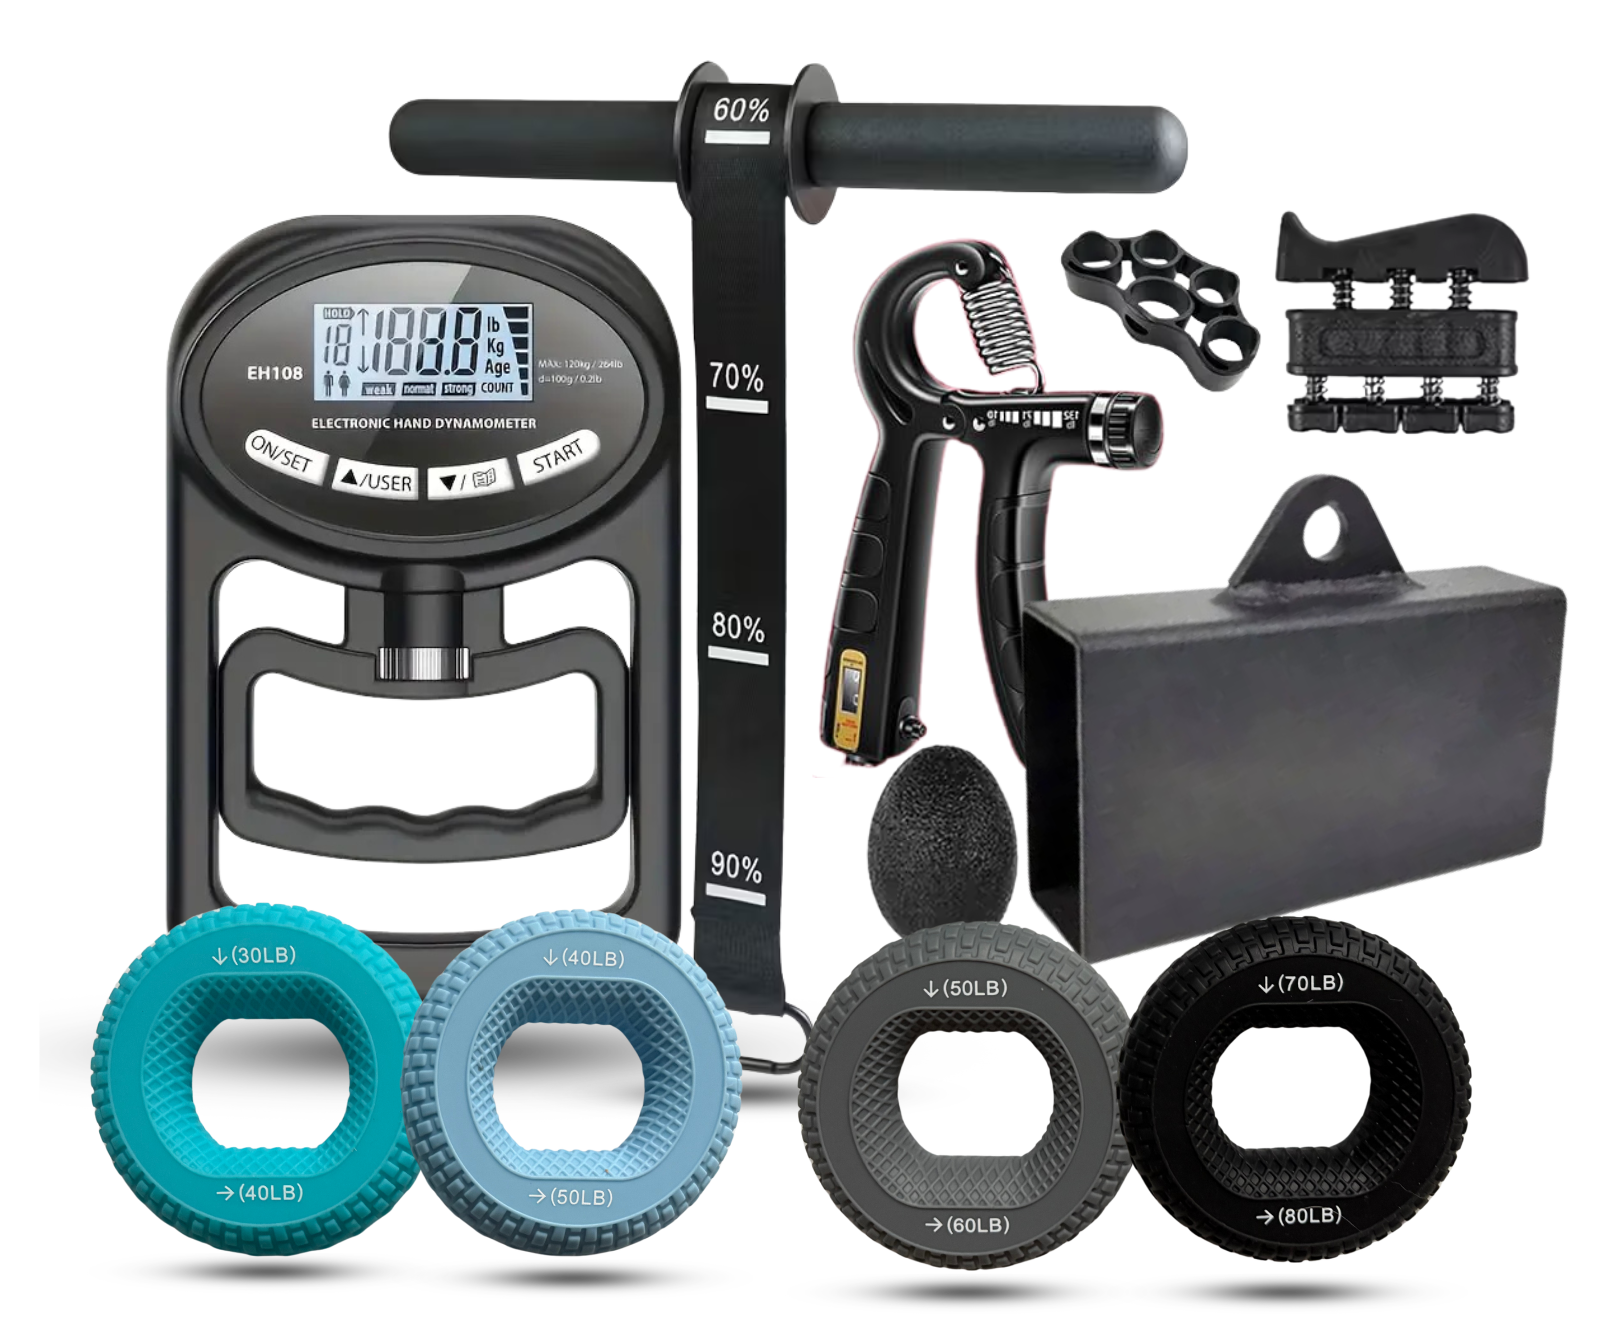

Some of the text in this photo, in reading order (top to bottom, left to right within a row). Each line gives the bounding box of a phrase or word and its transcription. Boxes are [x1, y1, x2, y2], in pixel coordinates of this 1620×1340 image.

[713, 97, 770, 122] 60%
[324, 309, 351, 319] HOLD
[487, 316, 500, 333] lb
[487, 337, 504, 357] Kg
[247, 366, 303, 381] EH108
[485, 358, 511, 378] Age
[709, 361, 764, 392] 70%
[365, 384, 394, 395] weak
[403, 384, 435, 395] normal
[444, 383, 475, 397] strong
[481, 382, 514, 394] COUNT
[312, 417, 537, 430] ELECTRONIC HAND DYNAMOMETER
[251, 435, 313, 473] ON/SET
[533, 438, 583, 473] START
[712, 611, 765, 643] 80%
[711, 850, 762, 884] 90%
[231, 945, 296, 967] (30LB)
[562, 948, 625, 969] (40LB)
[942, 977, 1008, 998] (50LB)
[1278, 973, 1344, 995] (70LB)
[239, 1182, 304, 1204] (40LB)
[549, 1187, 613, 1207] (50LB)
[946, 1215, 1011, 1236] (60LB)
[1278, 1205, 1343, 1227] (80LB)
